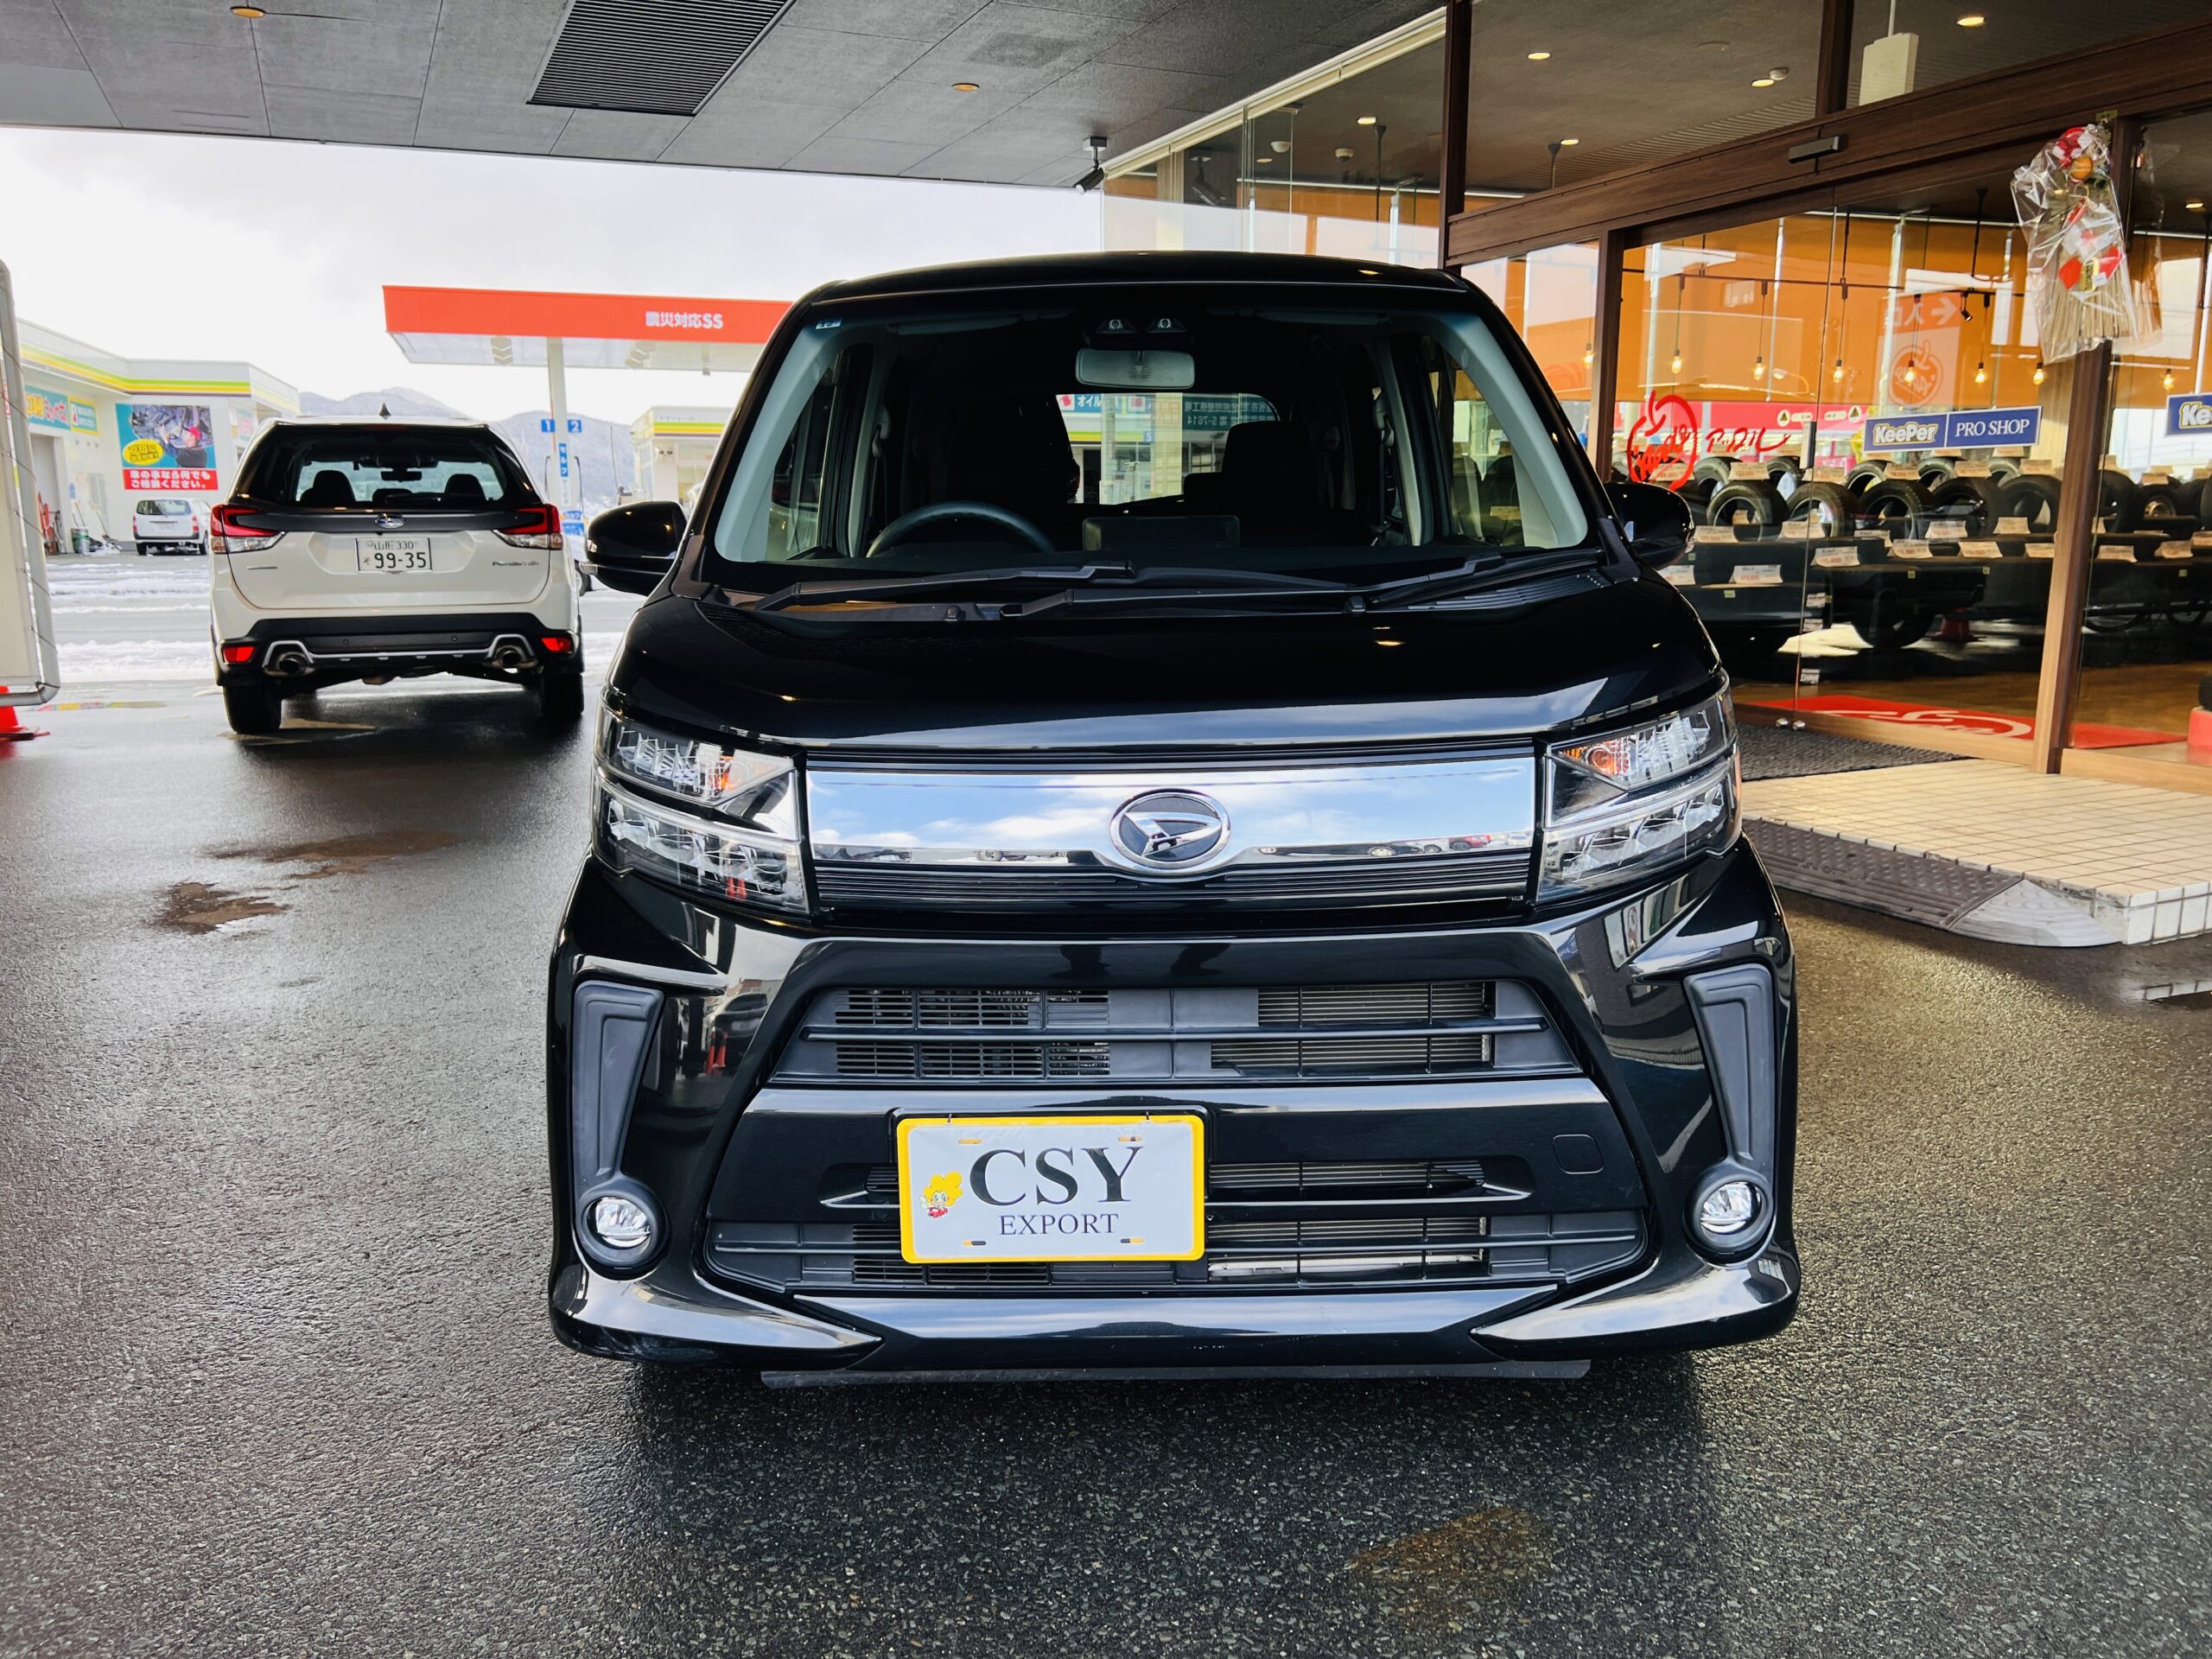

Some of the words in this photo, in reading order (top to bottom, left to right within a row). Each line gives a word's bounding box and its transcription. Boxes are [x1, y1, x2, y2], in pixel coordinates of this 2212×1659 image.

[645, 311, 724, 329] 震災対応SS
[544, 420, 551, 431] 1
[570, 420, 579, 432] 2
[1873, 422, 1938, 446] KeePer
[1955, 421, 1986, 437] PRO
[1988, 418, 2031, 435] SHOP
[397, 541, 414, 550] 330
[374, 552, 427, 569] 99-35
[969, 1146, 1145, 1206] CSY
[999, 1213, 1119, 1236] EXPORT
